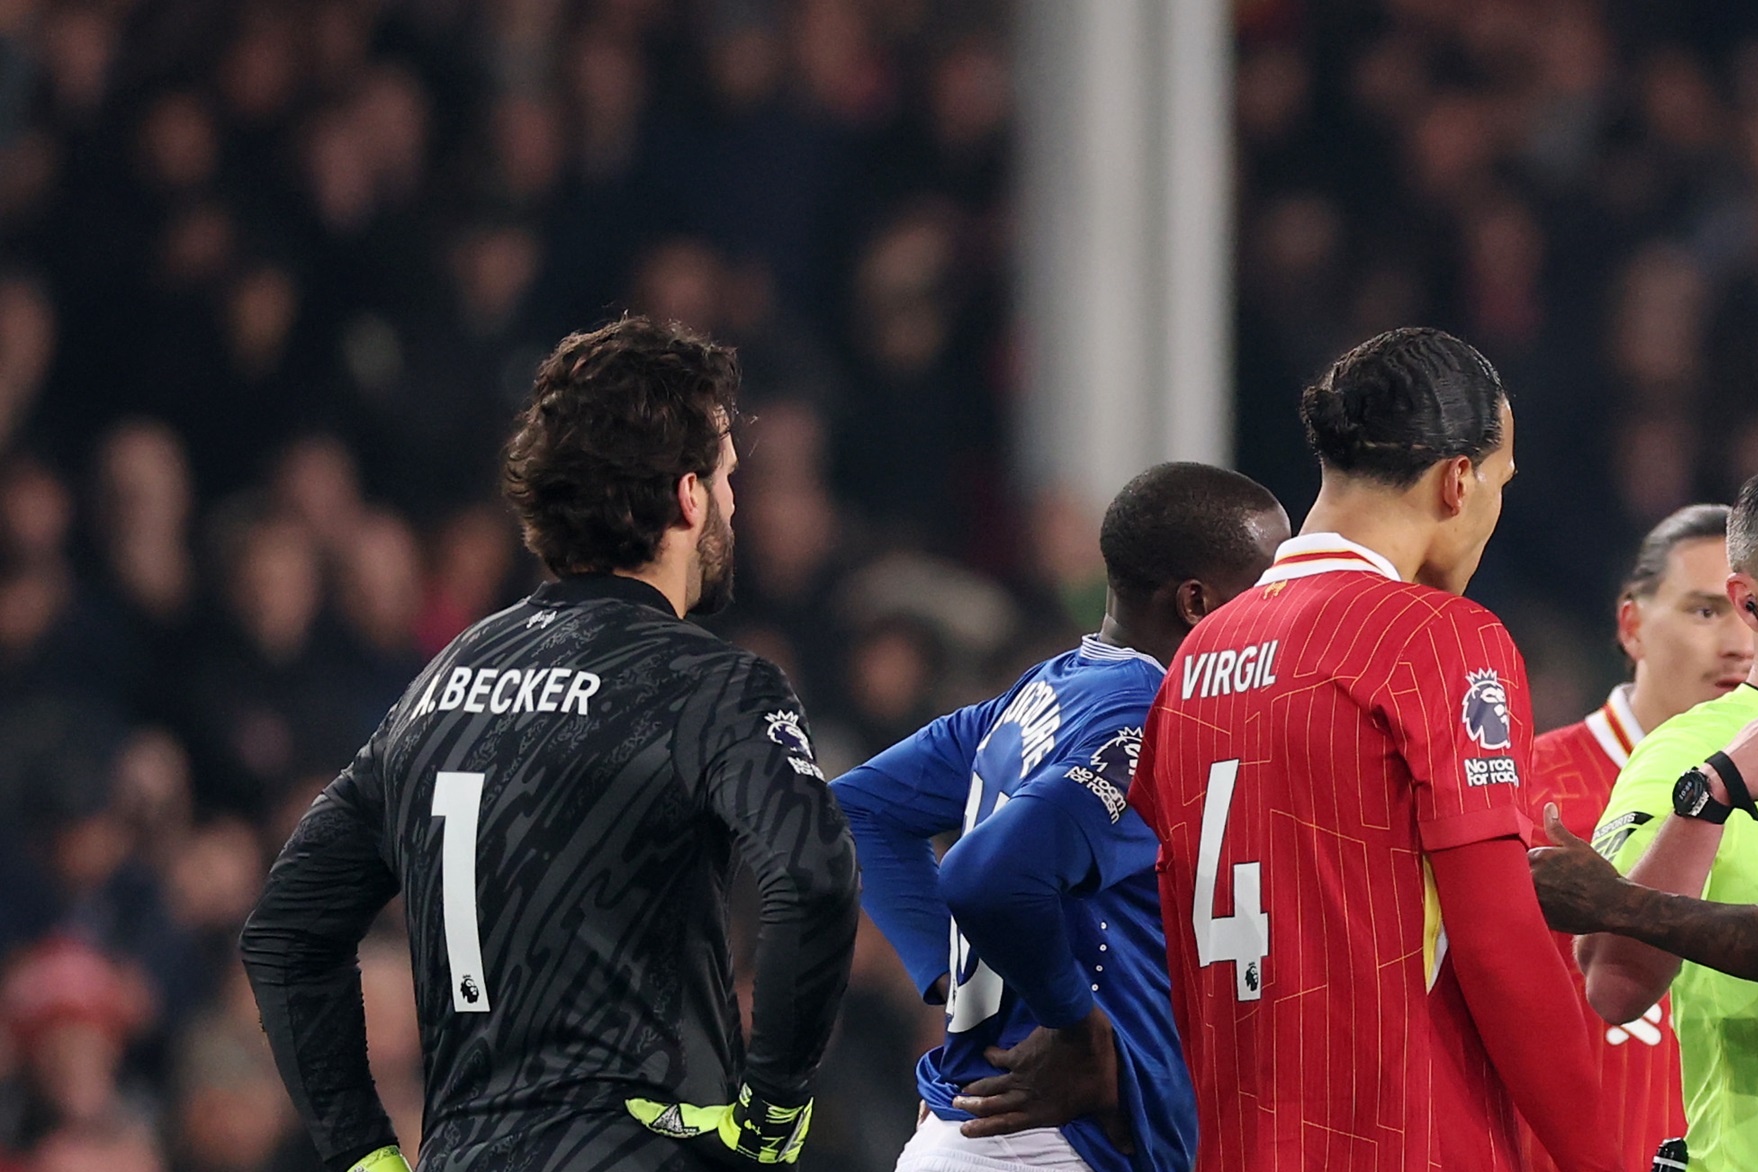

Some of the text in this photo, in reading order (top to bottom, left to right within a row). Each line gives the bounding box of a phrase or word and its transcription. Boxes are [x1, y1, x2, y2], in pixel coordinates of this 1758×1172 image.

[1181, 640, 1279, 699] VIRGIL
[1072, 766, 1127, 811] No room
[1464, 758, 1488, 773] No
[1063, 771, 1120, 824] for racism
[431, 771, 491, 1013] 1
[1192, 759, 1269, 1001] 4
